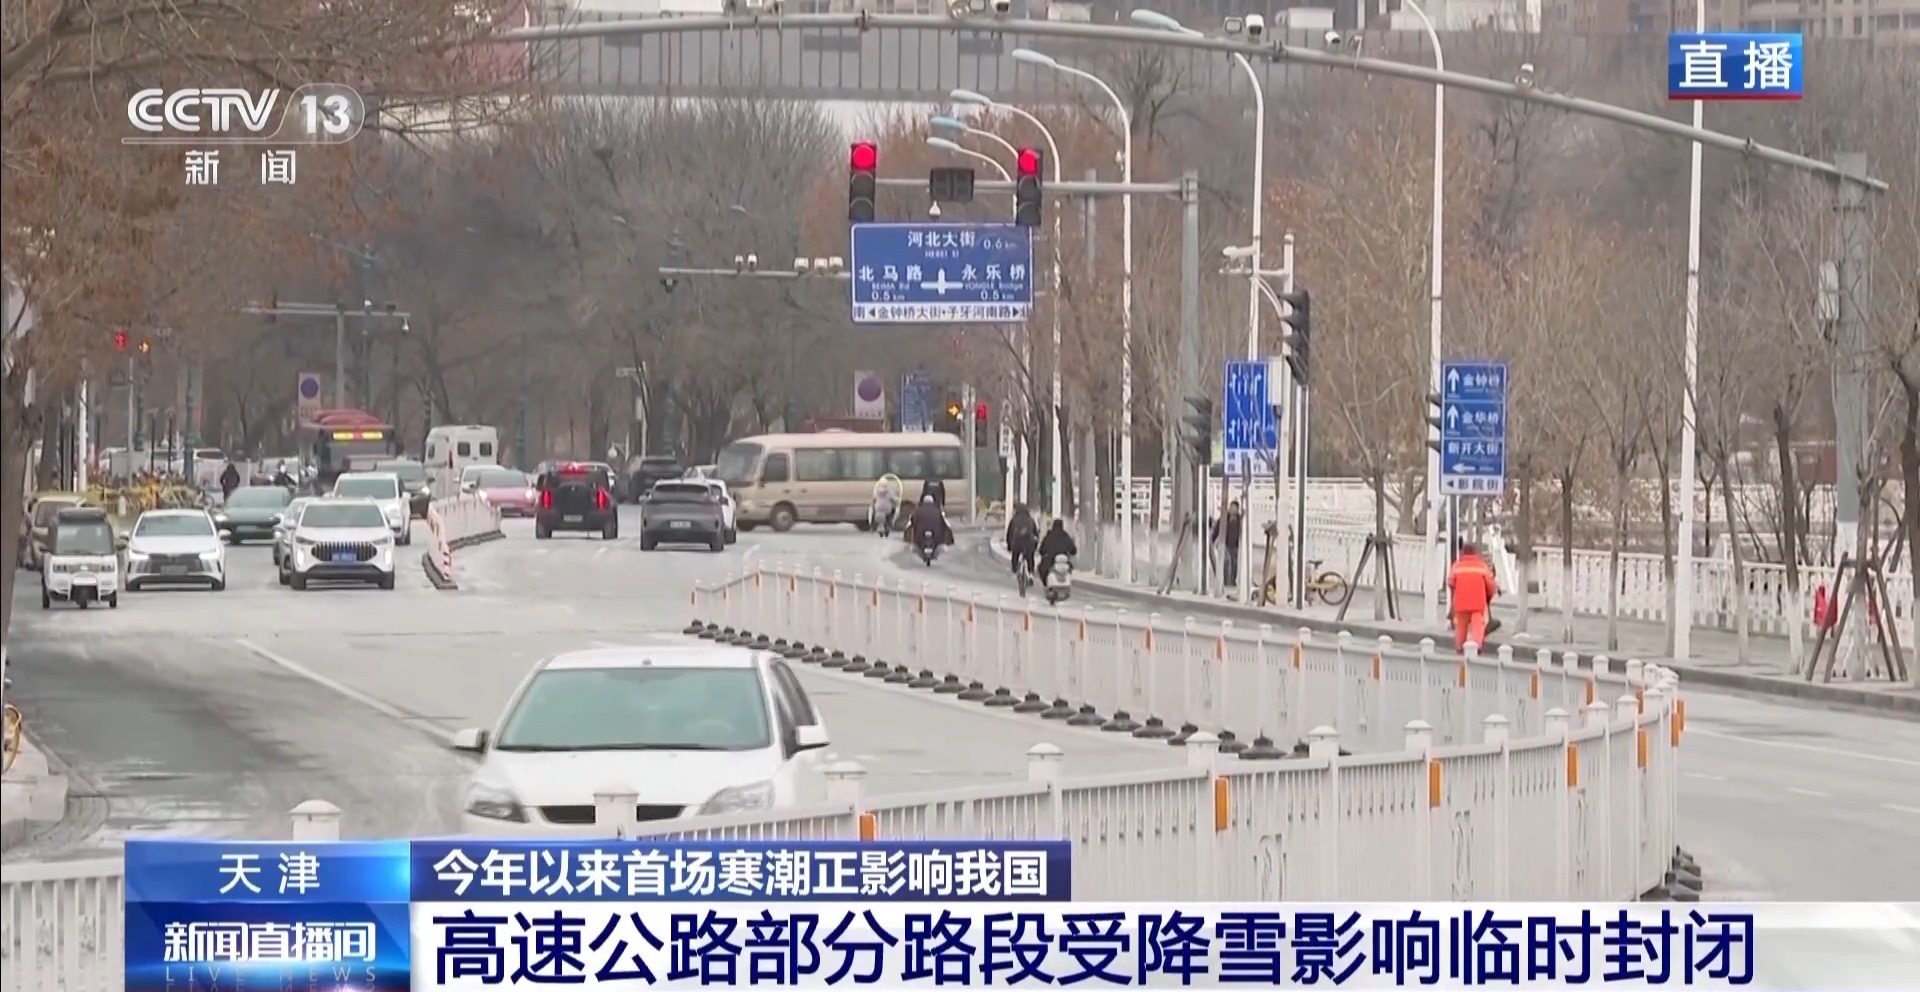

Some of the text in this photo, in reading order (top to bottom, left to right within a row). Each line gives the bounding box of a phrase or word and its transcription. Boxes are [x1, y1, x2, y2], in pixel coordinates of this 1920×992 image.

[907, 231, 976, 248] 河北大街
[858, 265, 923, 282] 北马路
[961, 264, 1026, 281] 永乐桥
[853, 306, 866, 319] 南
[1463, 372, 1500, 388] 金钟桥
[1462, 410, 1500, 425] 金华桥
[1448, 441, 1499, 456] 新开大街
[1458, 478, 1499, 491] 影院街
